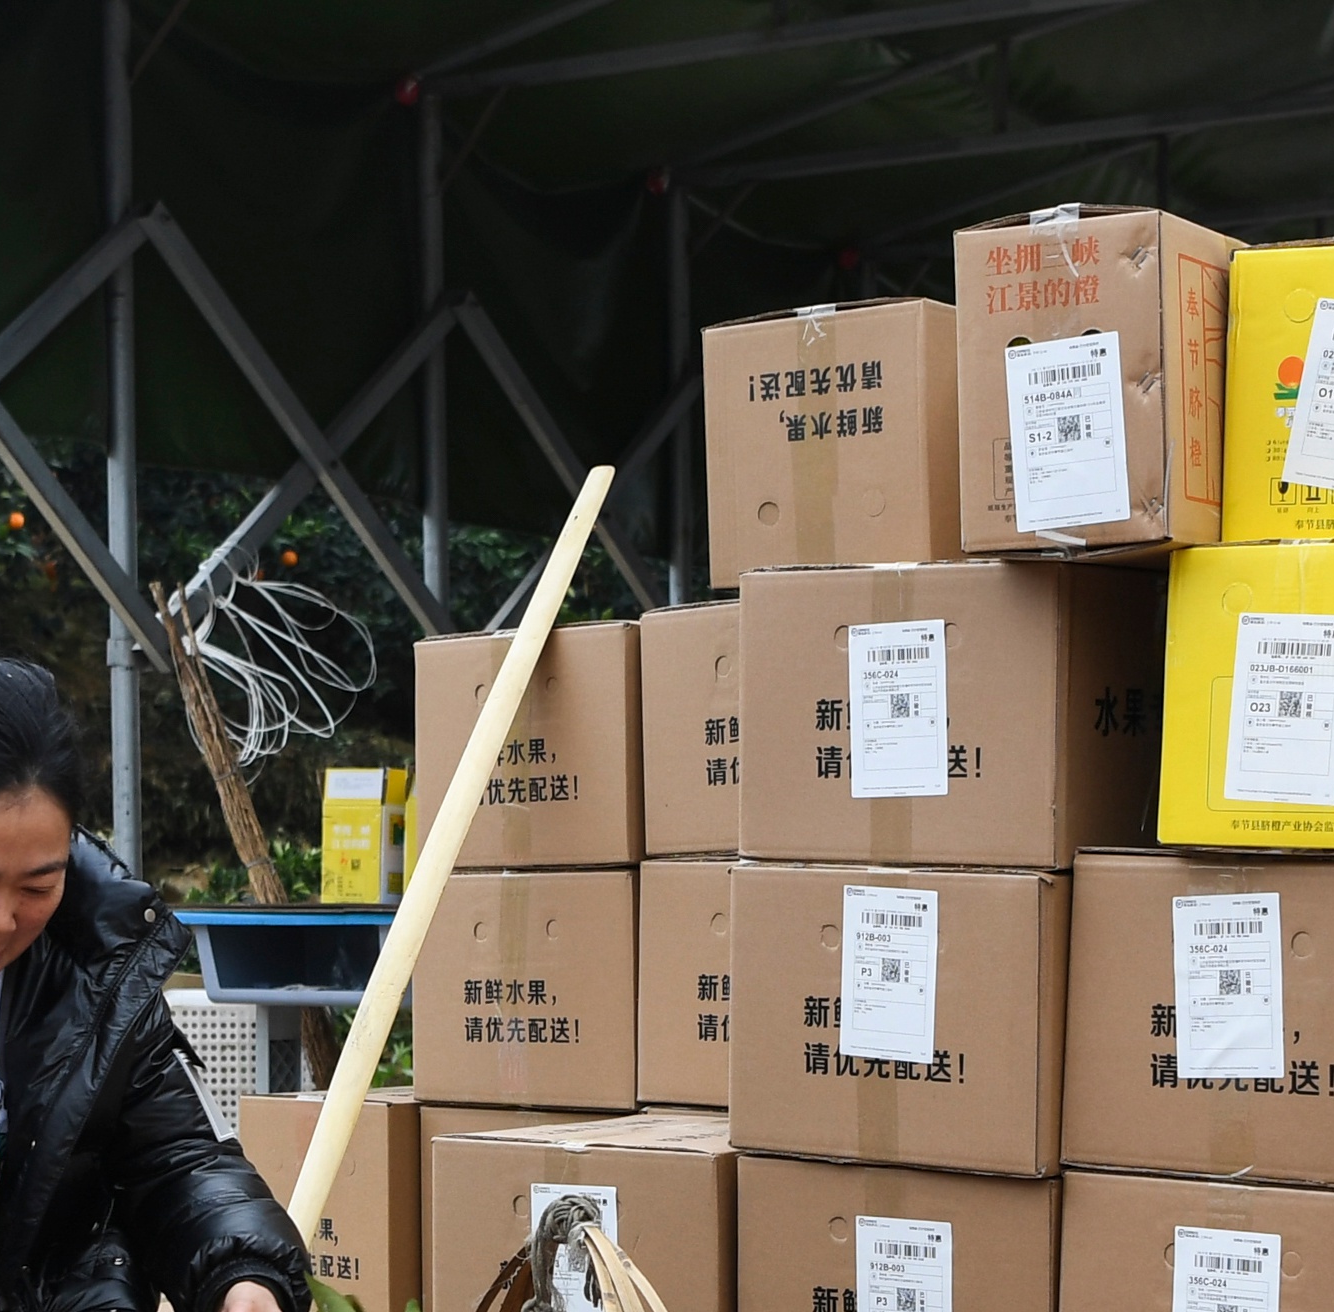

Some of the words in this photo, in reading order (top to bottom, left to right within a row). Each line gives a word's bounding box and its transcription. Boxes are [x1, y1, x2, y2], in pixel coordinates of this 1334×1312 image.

[985, 236, 1100, 277] 坐拥三峡
[985, 275, 1100, 314] 江景的橙
[749, 360, 883, 402] 请优先配送！
[1186, 287, 1204, 467] 奉节脐橙
[1023, 388, 1073, 405] 514B-084A
[779, 405, 884, 442] 新鲜水果，
[1028, 431, 1053, 443] S1-2
[478, 775, 578, 806] 优先配送！
[856, 932, 891, 943] 912B-003
[861, 967, 873, 978] P3
[464, 978, 558, 1006] 新鲜水果，
[464, 1016, 580, 1044] 请优先配送！
[869, 1261, 906, 1273] 912B-003
[1188, 1275, 1228, 1288] 356C-024
[876, 1296, 888, 1307] P3
